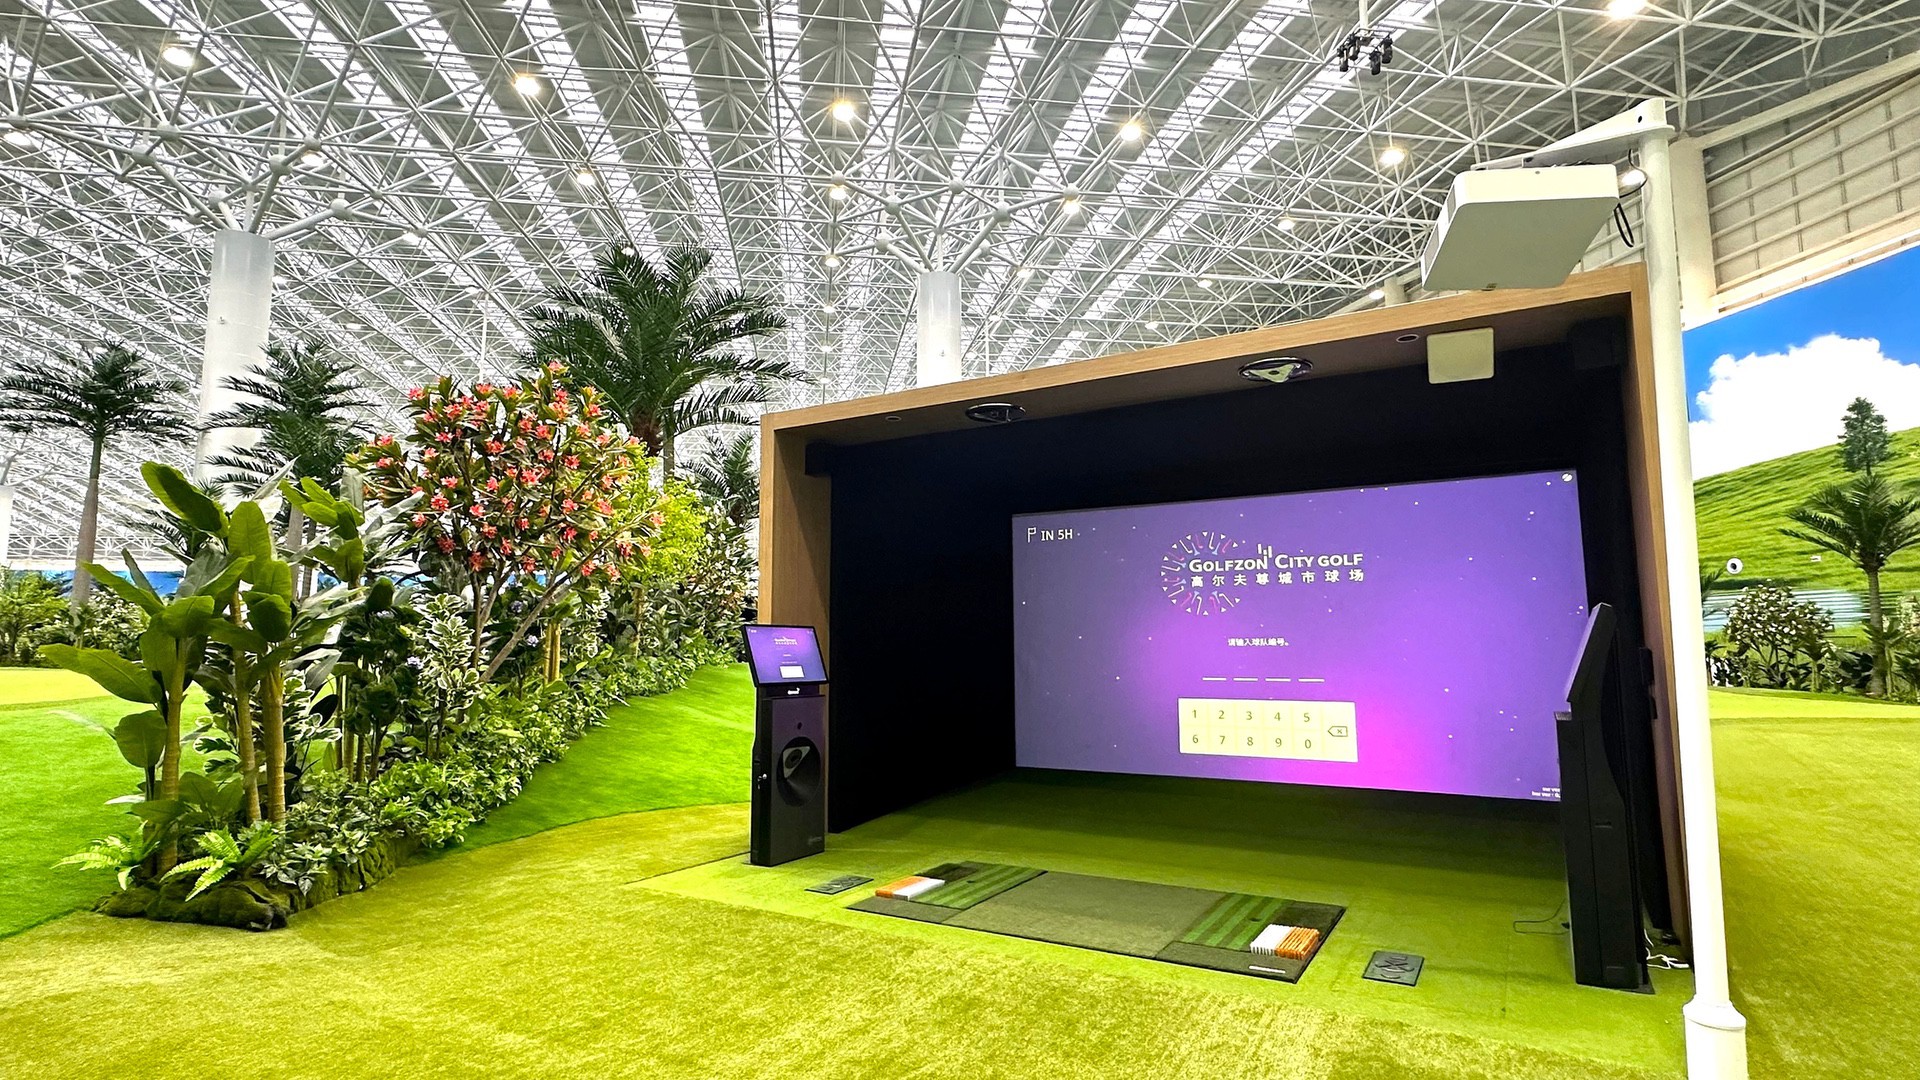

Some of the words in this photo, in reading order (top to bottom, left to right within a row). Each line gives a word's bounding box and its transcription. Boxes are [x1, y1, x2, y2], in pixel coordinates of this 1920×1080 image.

[1041, 530, 1054, 541] IN
[1058, 529, 1073, 540] 5H
[1189, 556, 1268, 572] GOLFZON
[1275, 554, 1314, 569] CITY
[1317, 553, 1364, 567] GOLF
[1192, 709, 1197, 719] 1
[1218, 709, 1225, 720] 2
[1246, 711, 1253, 721] 3
[1274, 712, 1281, 721] 4
[1303, 712, 1311, 723] 5
[1192, 734, 1199, 744] 6
[1219, 735, 1226, 745] 7
[1246, 736, 1254, 747] 8
[1275, 737, 1282, 748] 9
[1304, 739, 1312, 749] 0
